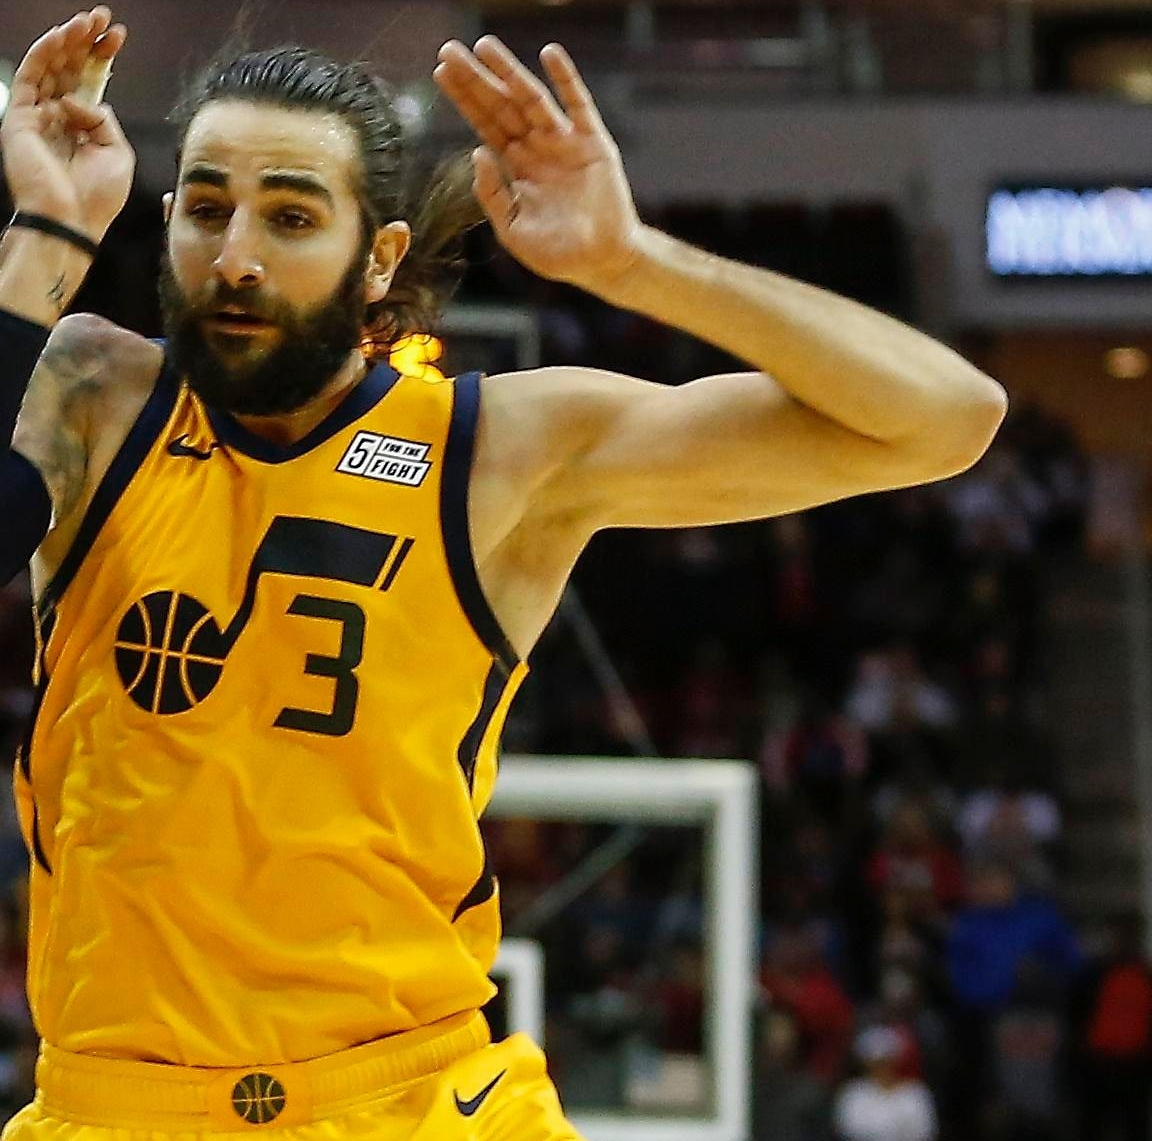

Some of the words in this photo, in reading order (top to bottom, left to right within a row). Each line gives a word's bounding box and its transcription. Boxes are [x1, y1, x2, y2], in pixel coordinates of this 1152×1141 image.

[348, 437, 376, 469] 5
[370, 459, 423, 481] FIGHT
[272, 594, 366, 736] 3
